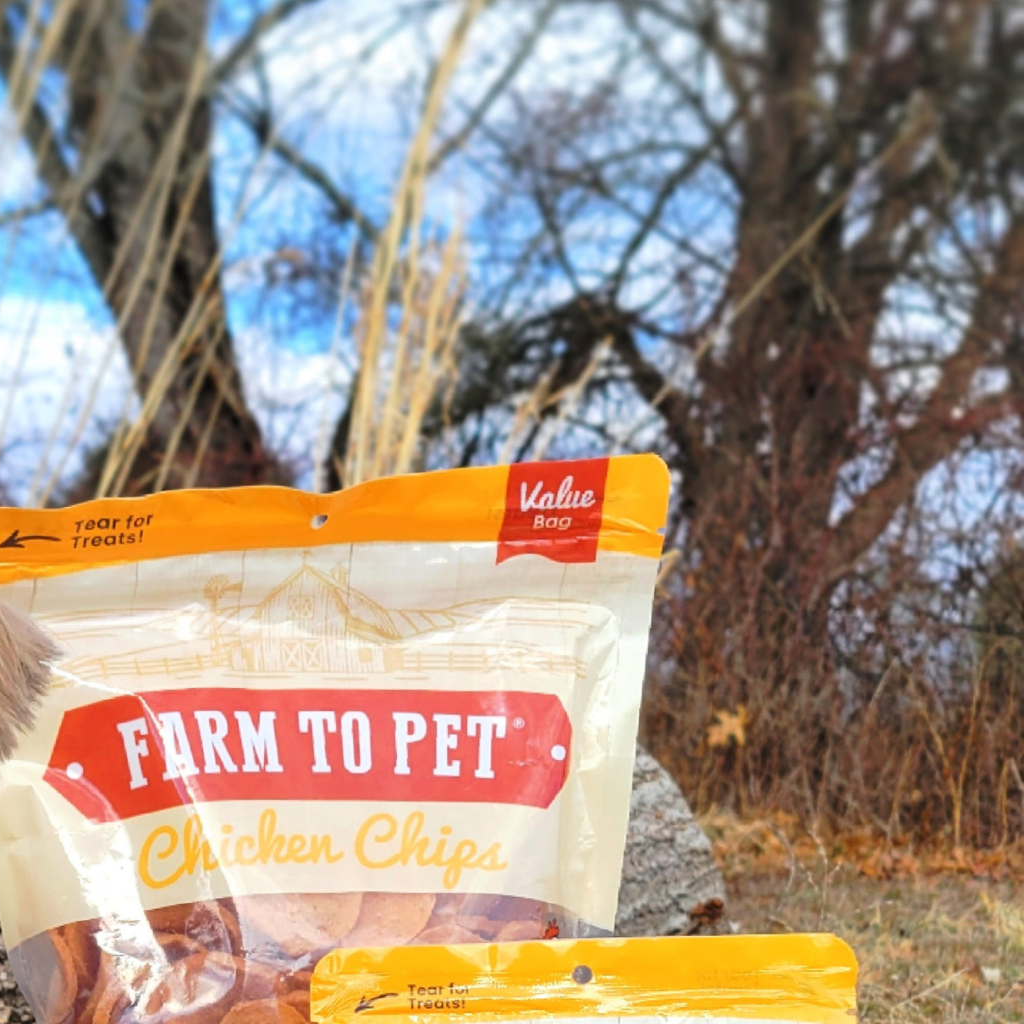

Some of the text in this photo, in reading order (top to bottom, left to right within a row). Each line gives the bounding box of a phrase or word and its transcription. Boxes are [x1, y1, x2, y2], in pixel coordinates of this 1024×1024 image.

[520, 475, 596, 512] Value
[74, 514, 154, 533] Tear for
[532, 515, 573, 530] Bag
[71, 530, 144, 549] Treats!
[116, 709, 283, 790] FARM
[298, 710, 372, 774] TO
[138, 808, 508, 891] Chicken Chips
[407, 984, 445, 996] Tear
[407, 997, 466, 1010] Treats!
